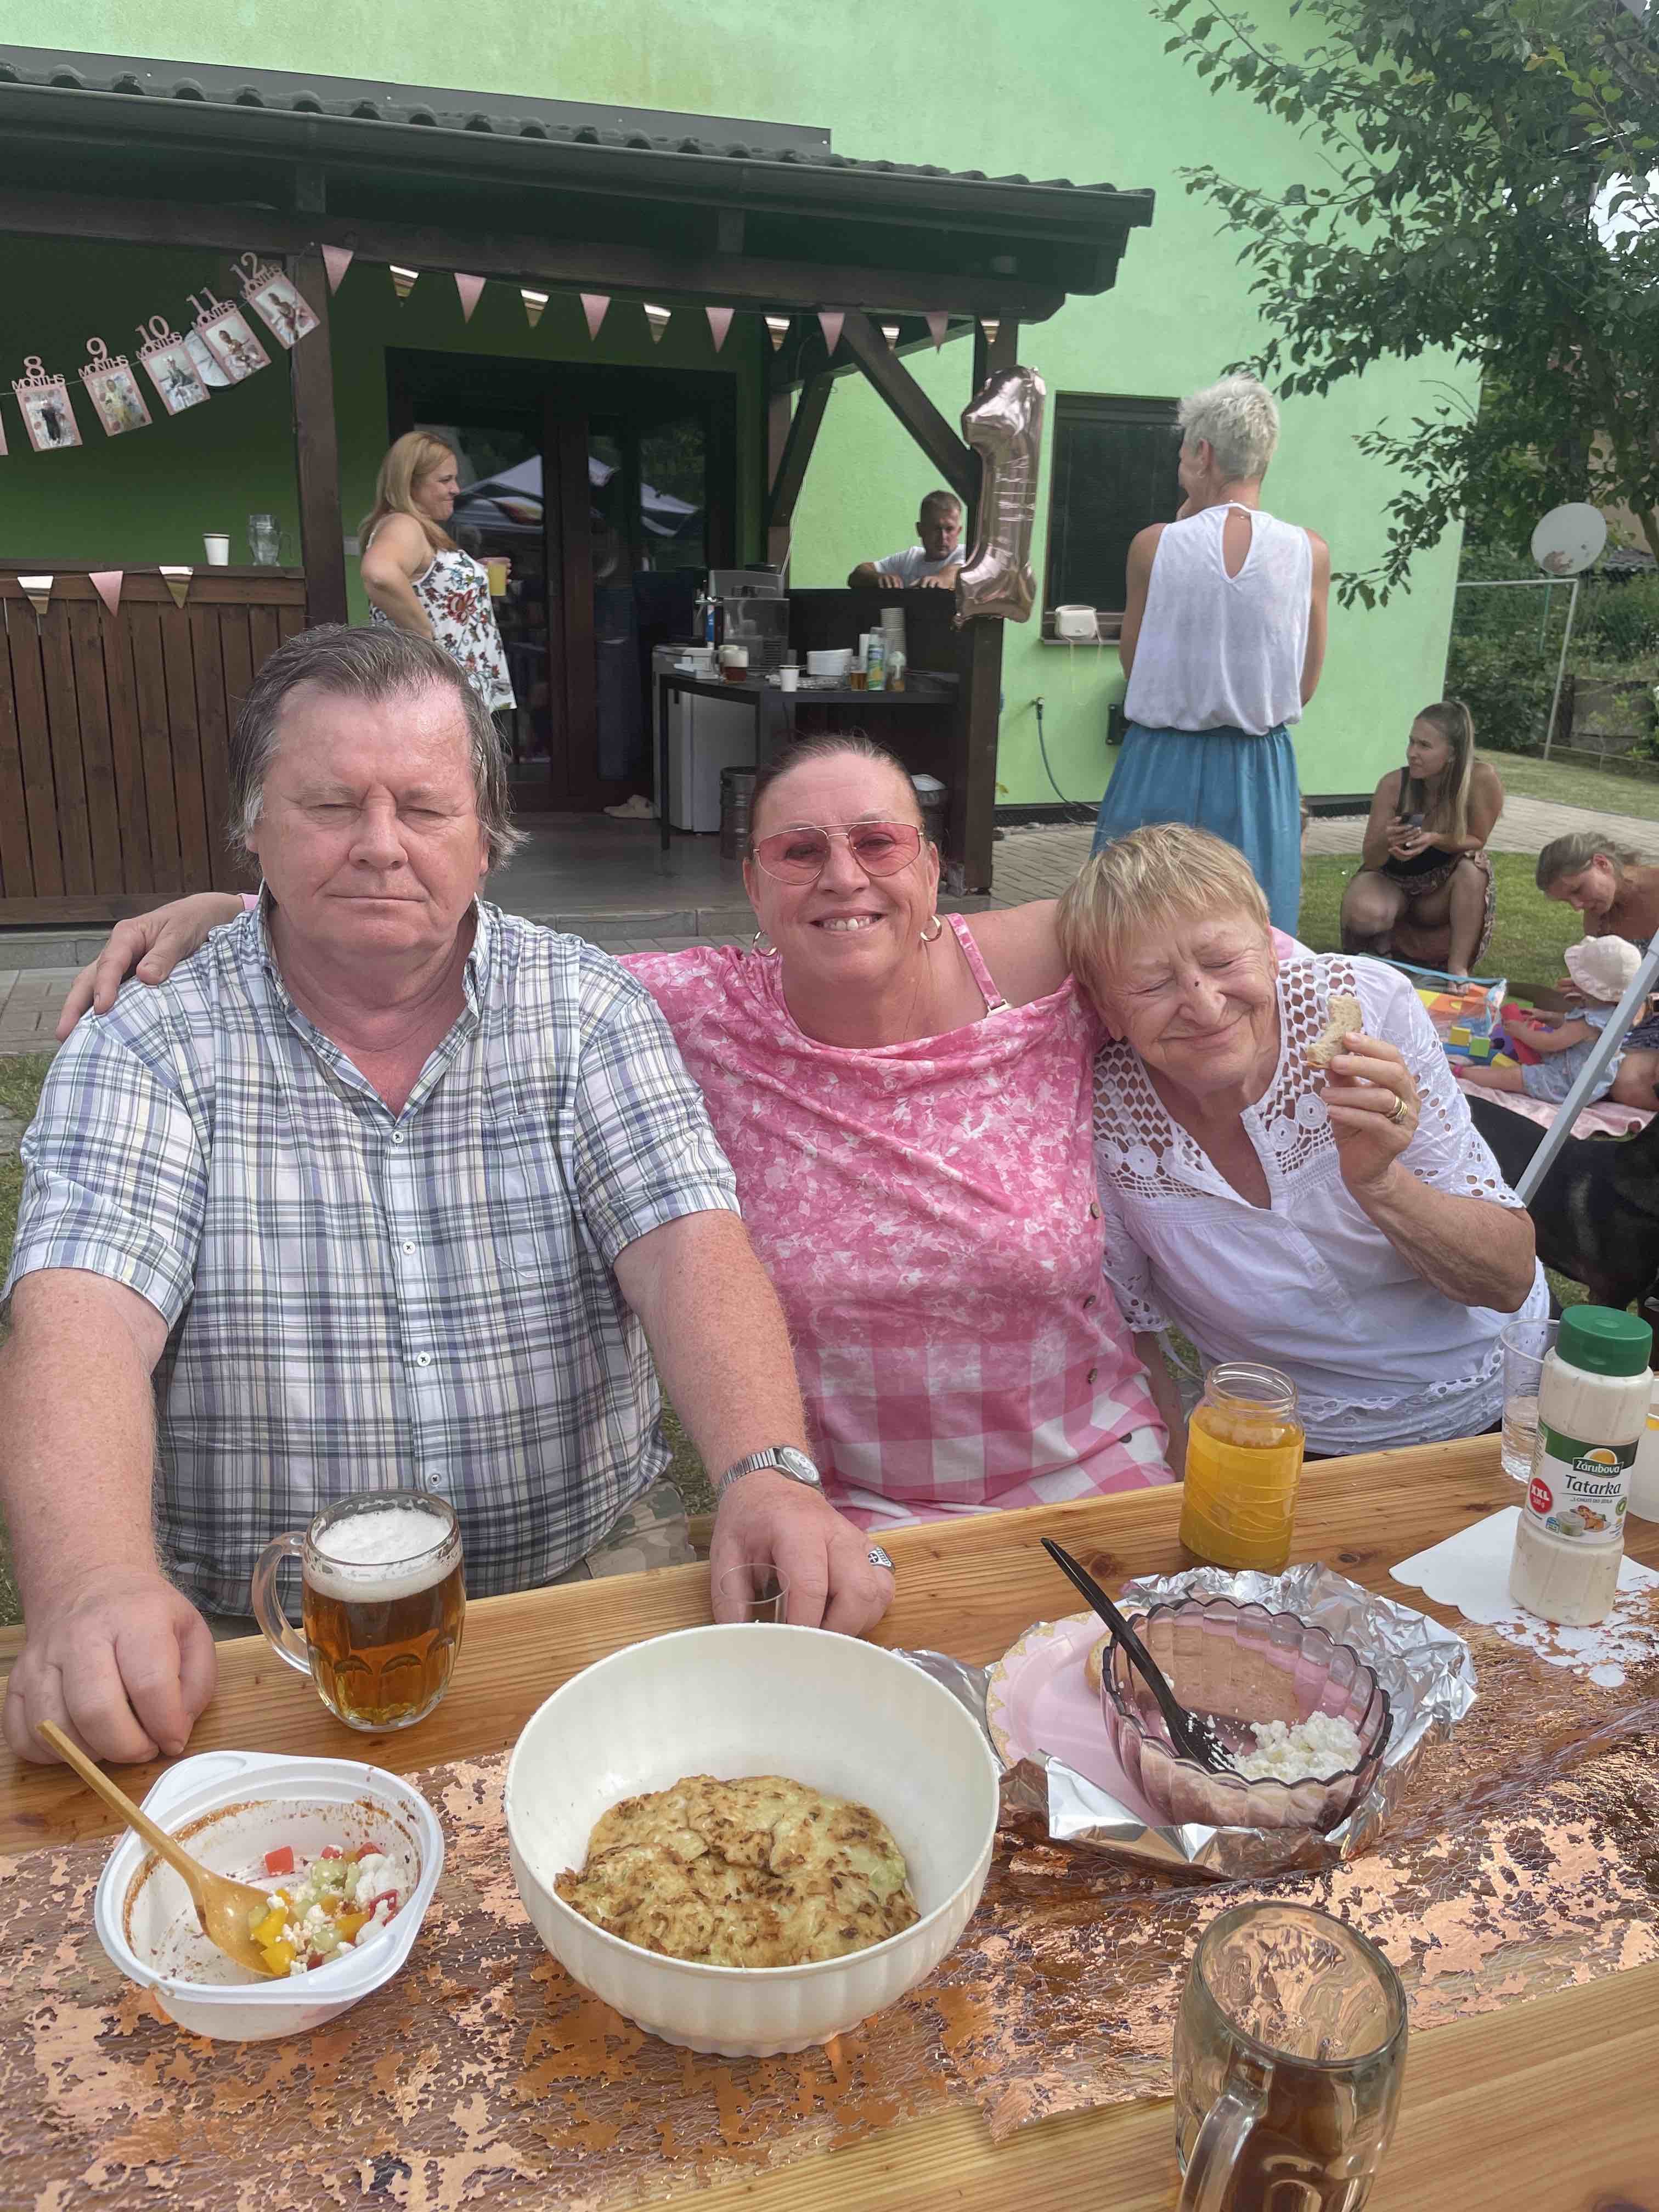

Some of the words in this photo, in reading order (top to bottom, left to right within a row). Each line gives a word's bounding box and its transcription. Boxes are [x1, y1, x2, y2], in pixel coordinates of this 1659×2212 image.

[229, 252, 264, 281] 12
[240, 264, 282, 300] MONTHS
[186, 287, 219, 313] 11
[135, 315, 170, 341] 10
[190, 300, 237, 333] MONTHS
[86, 337, 108, 363] 9
[136, 331, 183, 360] MONTHS
[24, 356, 45, 377] 8
[78, 355, 128, 379] MONTHS
[12, 374, 65, 390] MONTHS
[1576, 1460, 1620, 1474] Zárubova
[1531, 1484, 1549, 1502] XXL
[1565, 1474, 1621, 1494] Tatarka
